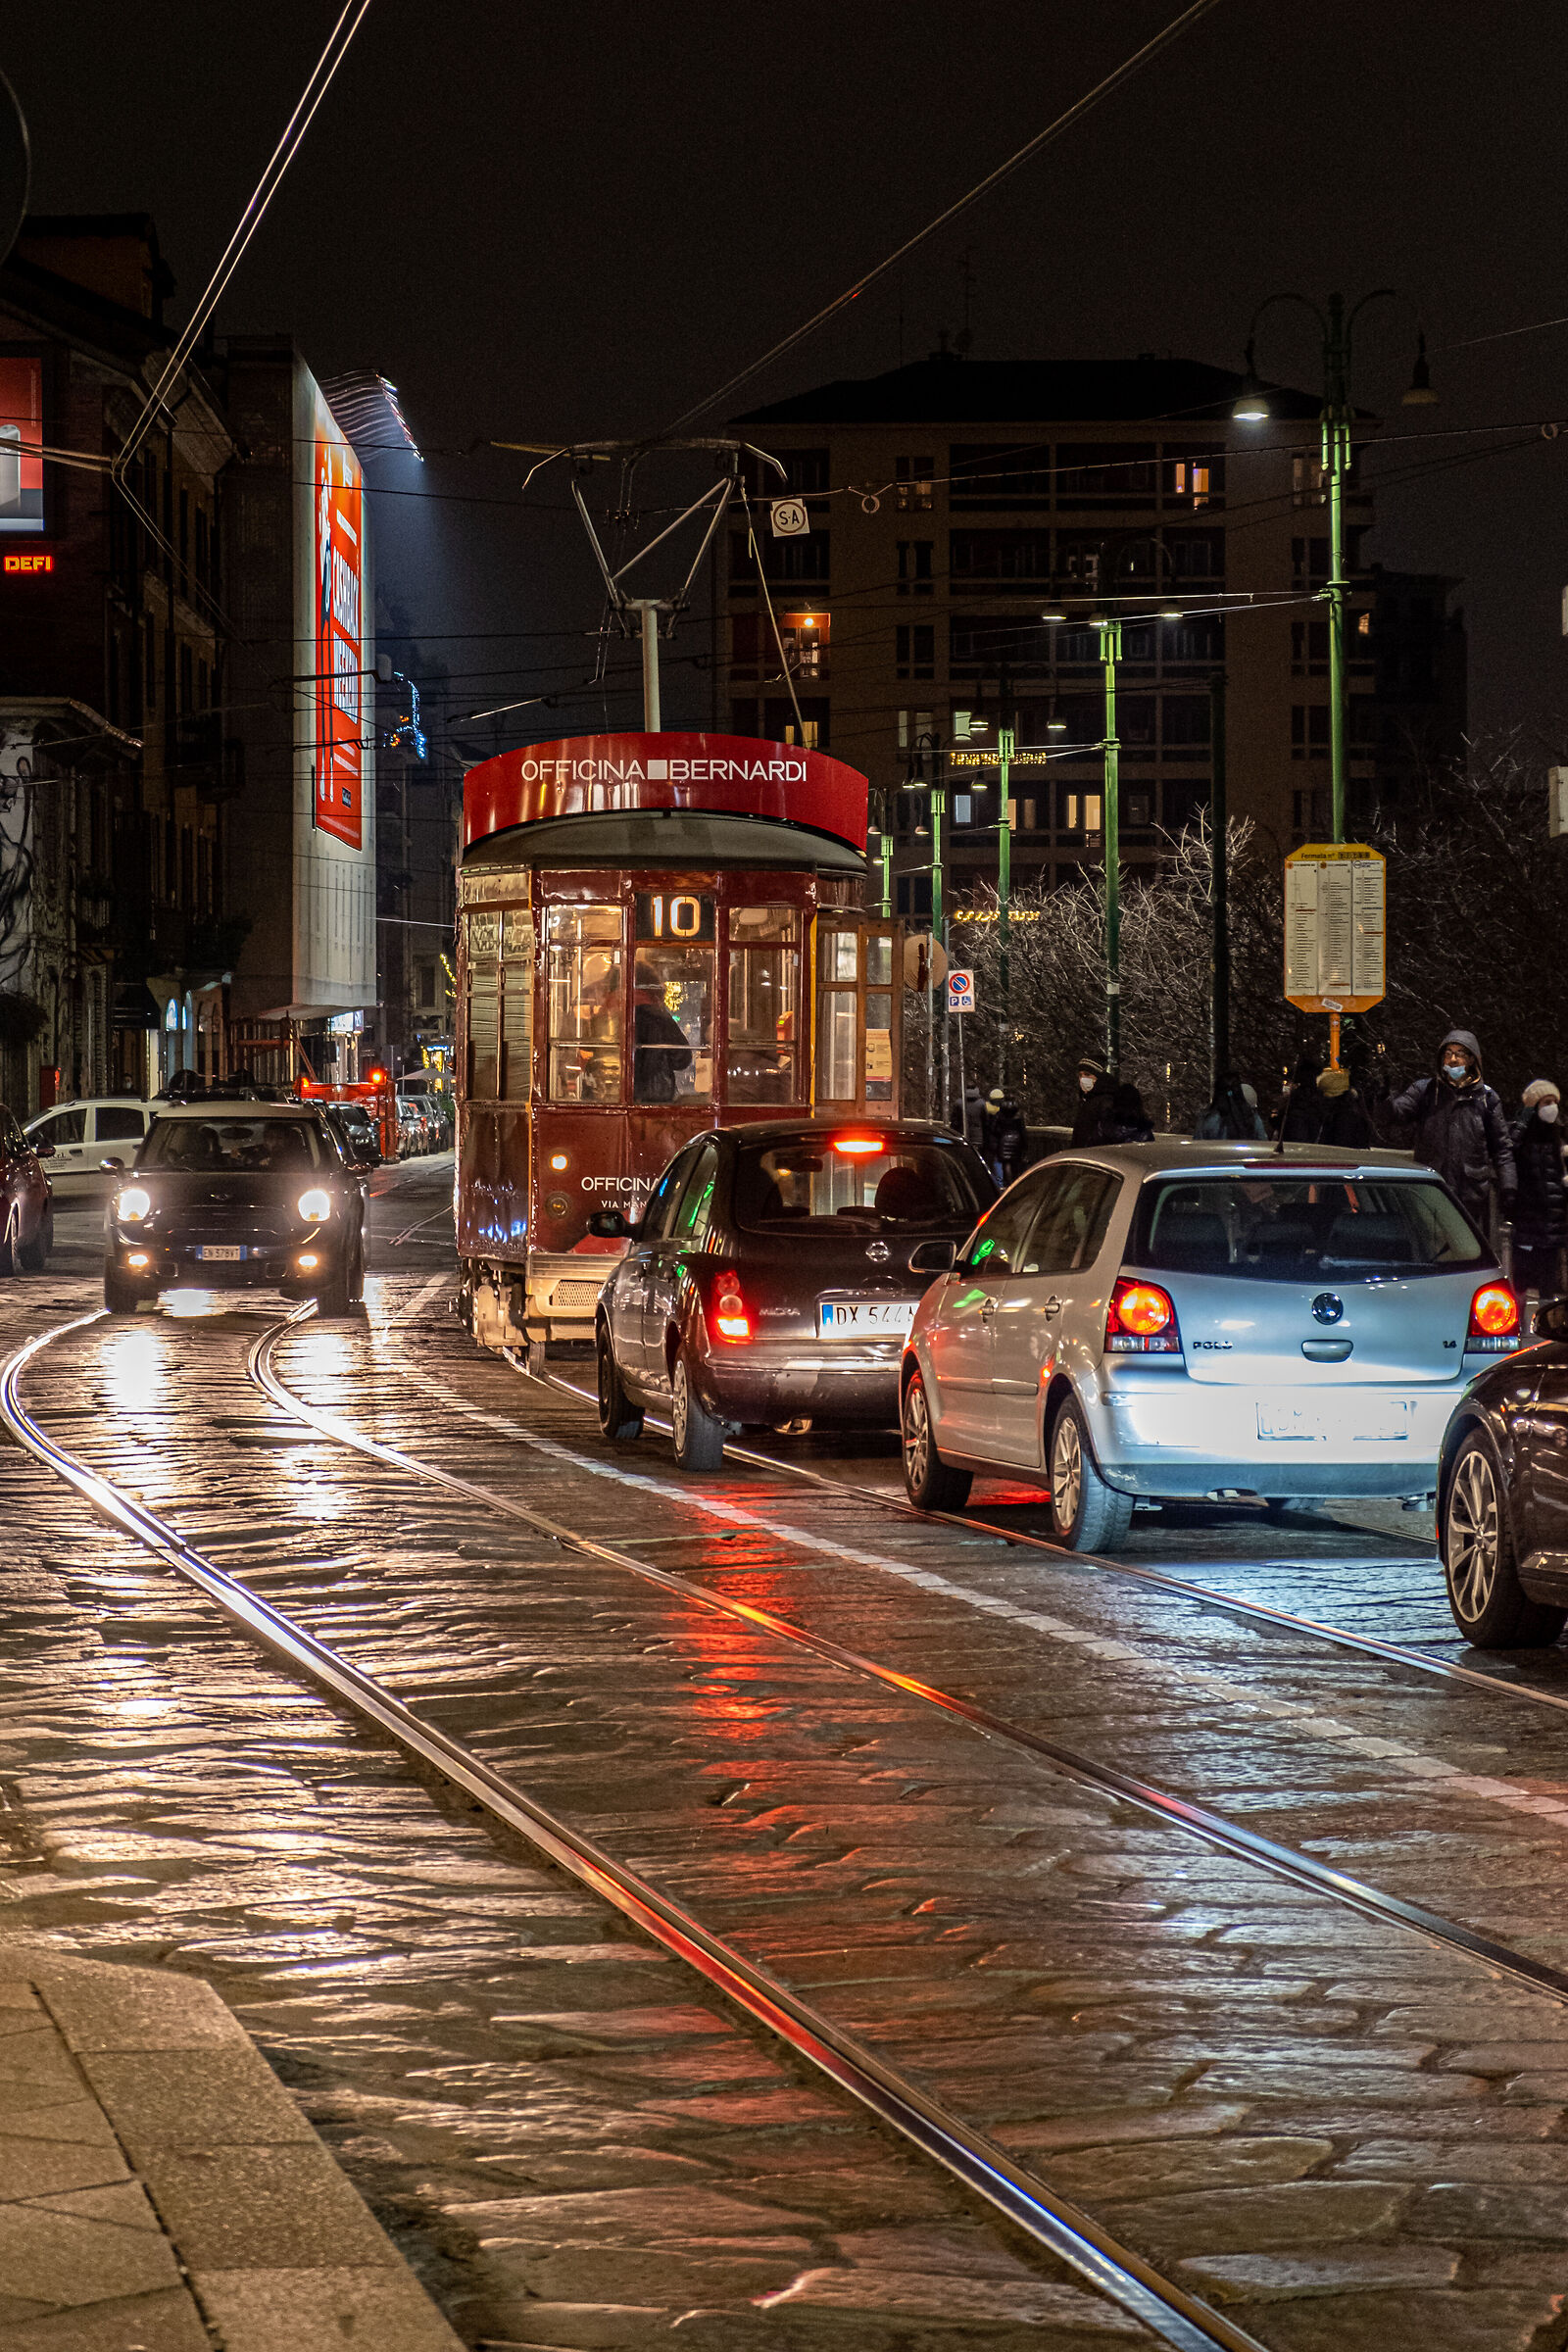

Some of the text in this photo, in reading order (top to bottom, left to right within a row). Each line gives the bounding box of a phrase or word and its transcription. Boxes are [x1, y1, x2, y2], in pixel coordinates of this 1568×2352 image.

[4, 556, 52, 571] DEFI
[521, 760, 807, 784] OFFICINA BERNARDI
[652, 896, 701, 937] 10
[836, 1306, 858, 1325] DX
[1193, 1341, 1233, 1349] POLO
